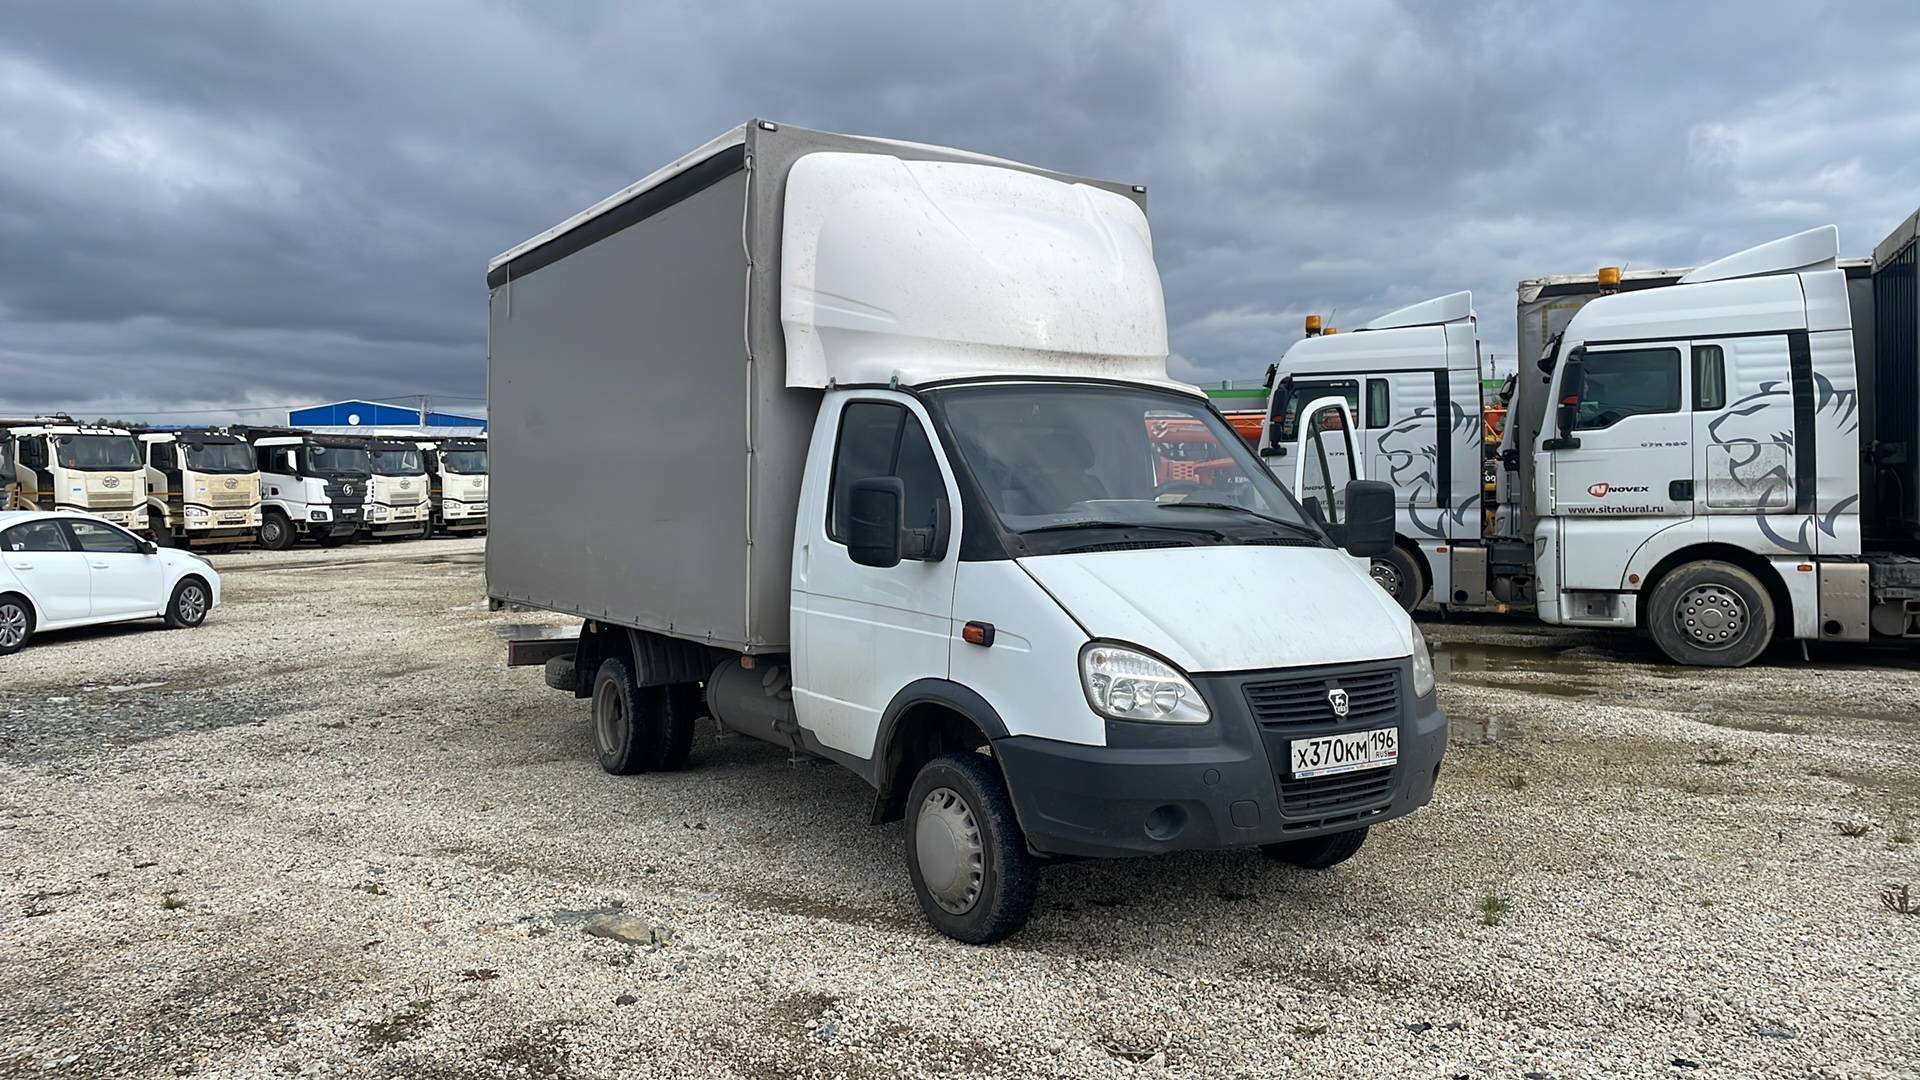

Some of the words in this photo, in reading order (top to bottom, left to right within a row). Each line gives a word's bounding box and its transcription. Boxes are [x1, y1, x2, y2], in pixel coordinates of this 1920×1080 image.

[1568, 504, 1664, 514] www.sitrakural.ru
[1370, 730, 1394, 751] 196
[1375, 750, 1388, 758] RUS
